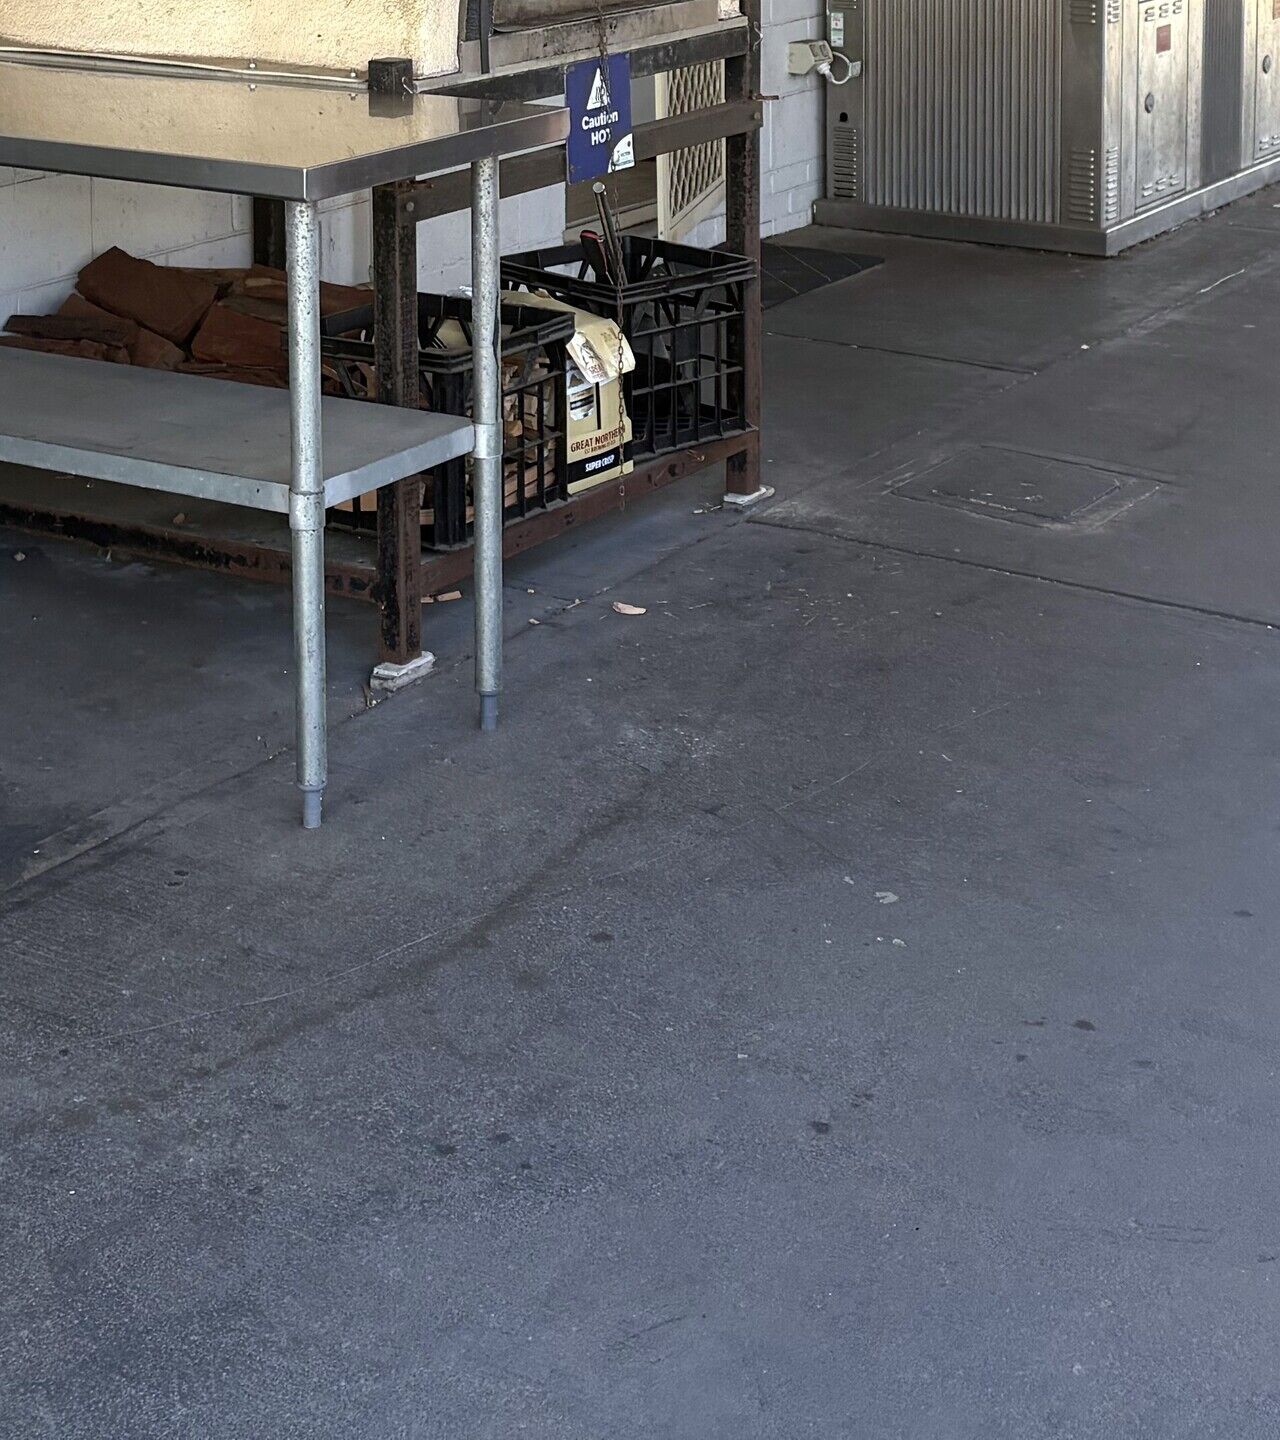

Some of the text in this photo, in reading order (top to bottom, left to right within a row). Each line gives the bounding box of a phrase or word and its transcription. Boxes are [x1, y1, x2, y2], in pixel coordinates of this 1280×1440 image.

[570, 437, 594, 453] GREAT
[585, 454, 615, 472] SUPER CRISP
